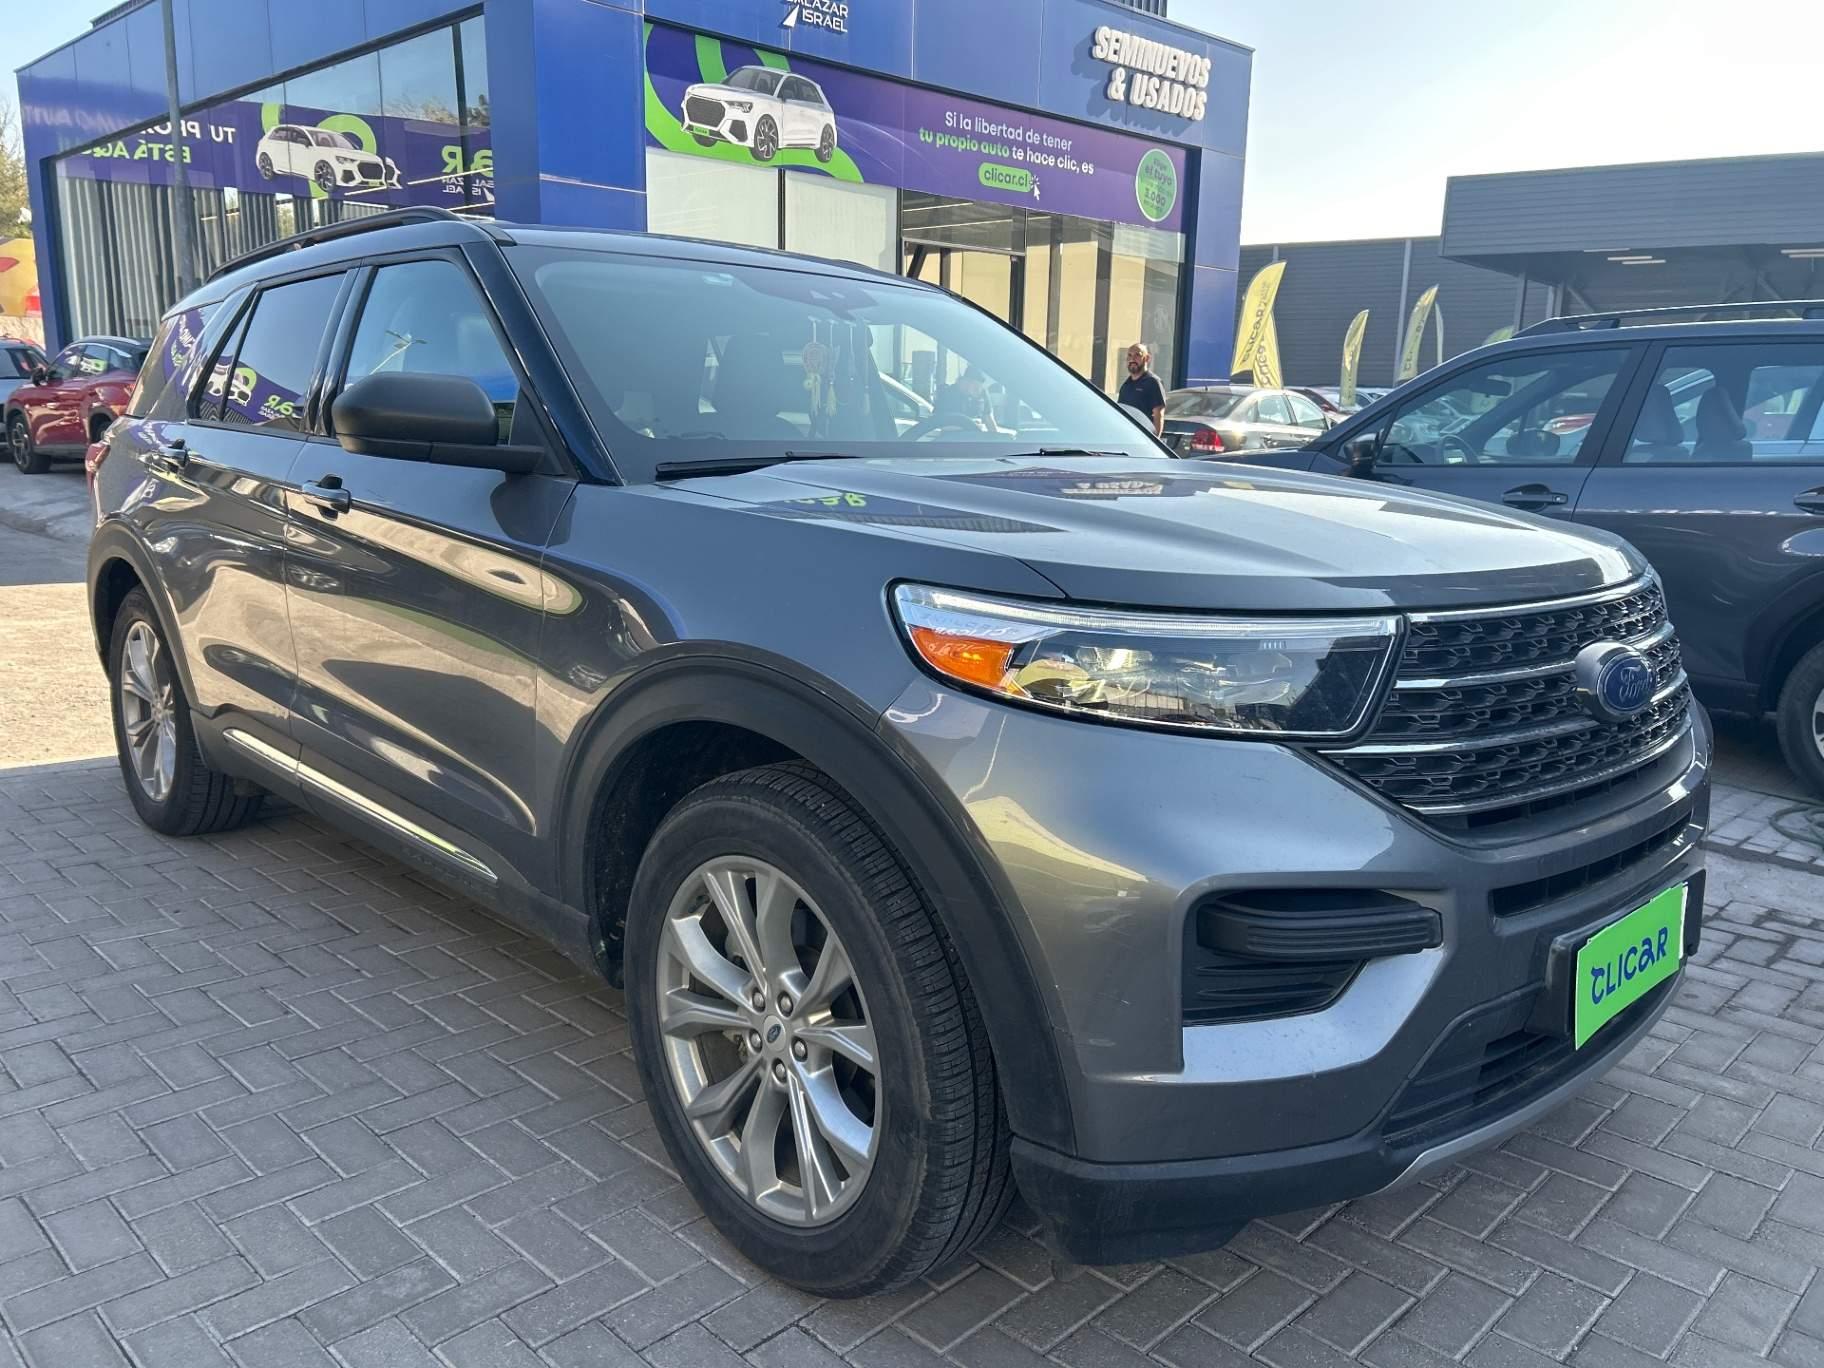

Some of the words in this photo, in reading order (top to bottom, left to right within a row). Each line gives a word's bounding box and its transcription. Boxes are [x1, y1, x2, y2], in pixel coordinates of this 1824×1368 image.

[802, 8, 848, 33] ISRAEL
[1092, 26, 1211, 88] SEMINUEVOS
[1107, 67, 1126, 101] &
[1129, 73, 1208, 121] USADOS
[919, 127, 934, 144] tu
[936, 134, 978, 152] propio
[980, 140, 1010, 158] auto
[1011, 146, 1024, 161] te
[1026, 147, 1056, 167] hace
[1057, 155, 1080, 174] clic,
[1081, 161, 1094, 175] es
[945, 111, 957, 127] Si
[960, 114, 972, 131] la
[974, 117, 1023, 141] libertad
[1025, 129, 1041, 145] de
[1042, 134, 1072, 152] tener
[983, 167, 1028, 188] clicar.cl
[1618, 665, 1650, 702] Ford
